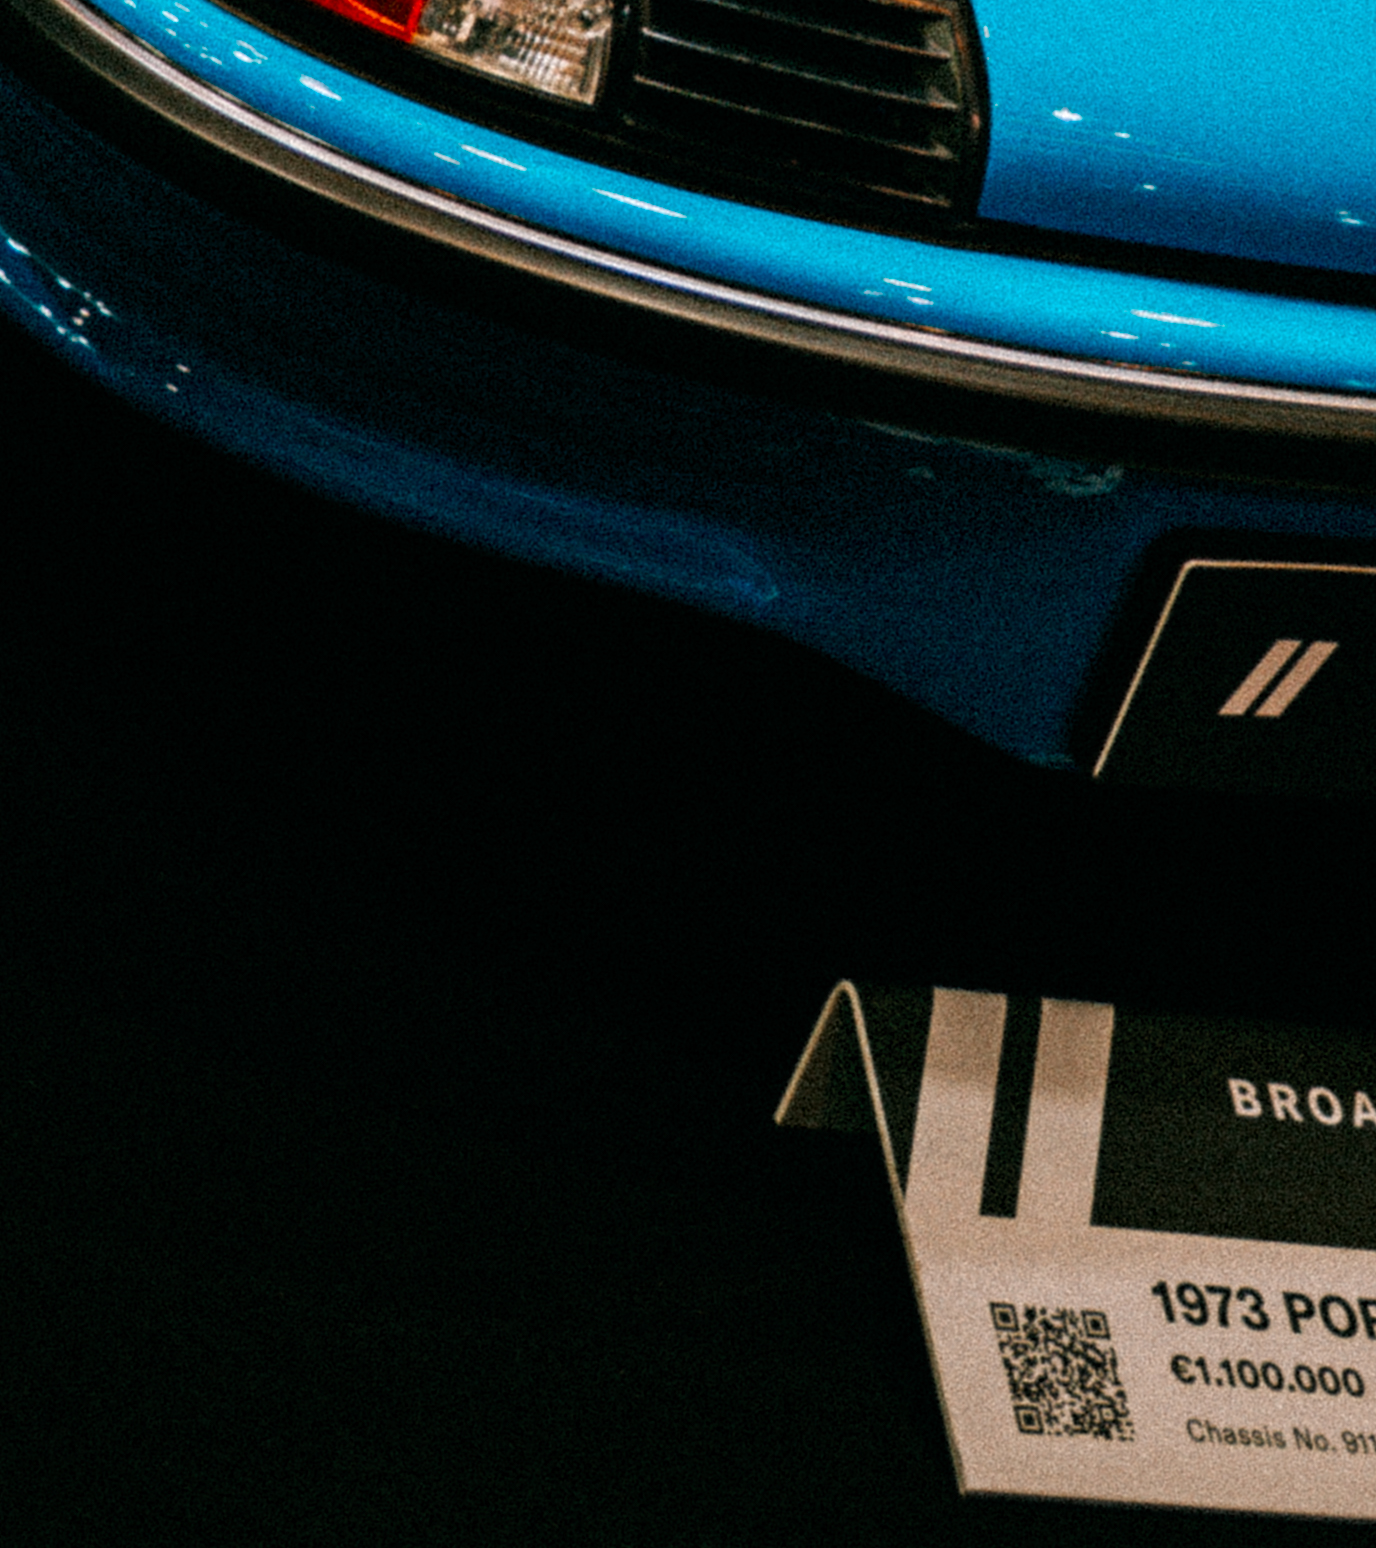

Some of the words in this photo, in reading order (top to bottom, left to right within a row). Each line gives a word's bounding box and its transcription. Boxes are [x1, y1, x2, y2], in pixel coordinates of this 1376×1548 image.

[1151, 1280, 1270, 1332] 1973
[1170, 1354, 1366, 1398] €1.100.000
[1186, 1418, 1286, 1448] Chassis
[1293, 1427, 1337, 1453] No.
